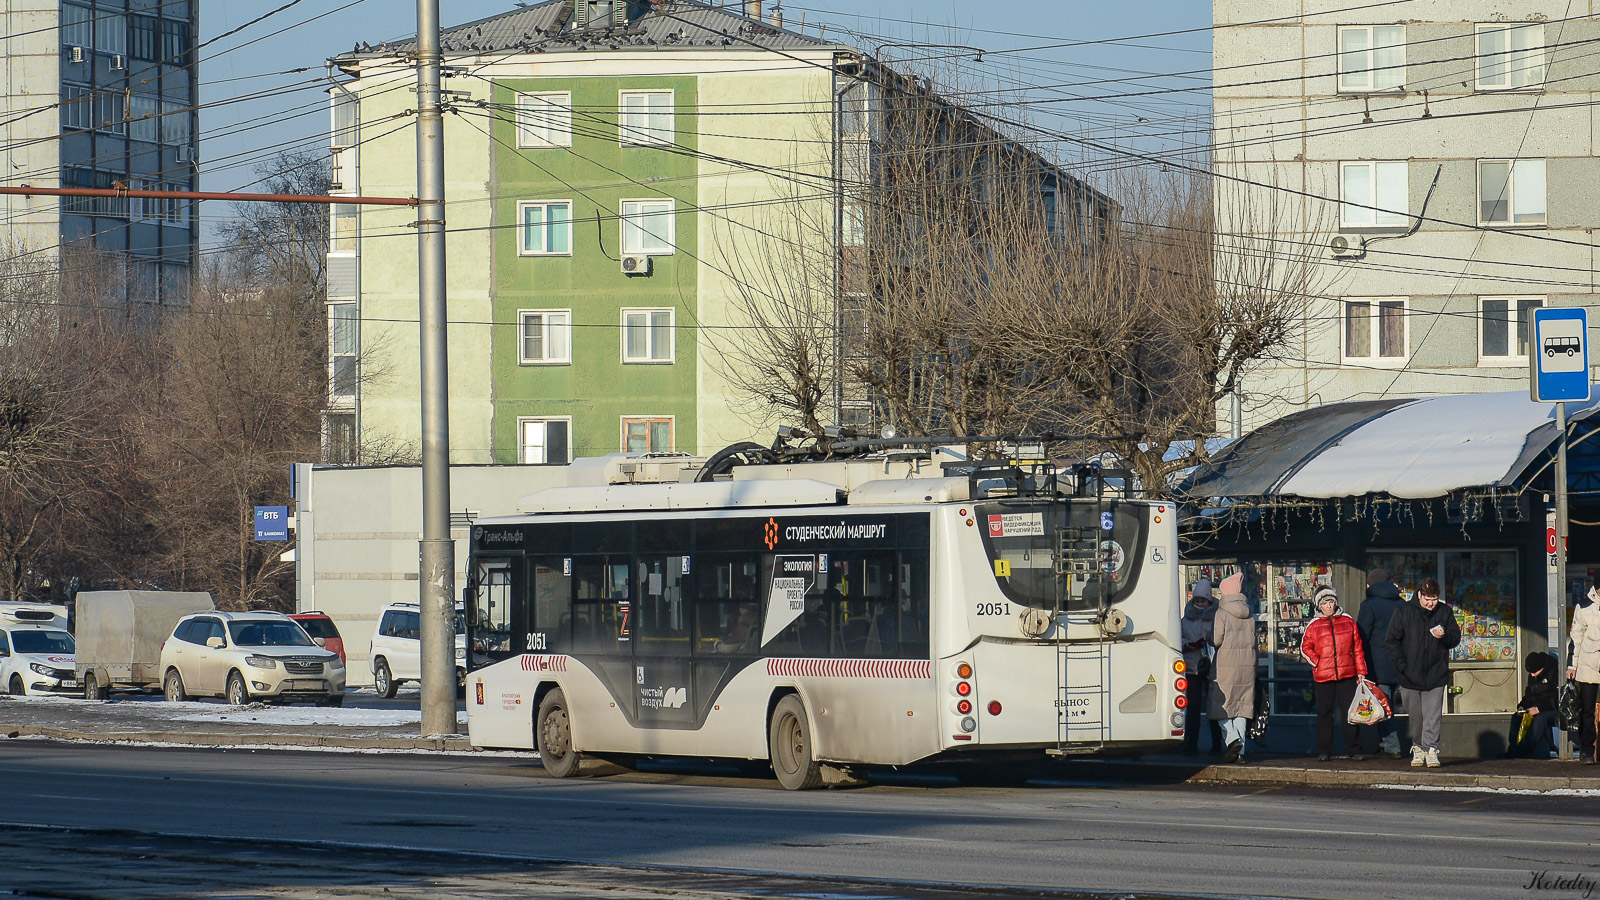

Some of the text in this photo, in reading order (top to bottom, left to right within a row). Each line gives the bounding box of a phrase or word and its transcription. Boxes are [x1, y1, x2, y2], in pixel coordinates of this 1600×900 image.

[263, 511, 279, 520] ВТБ
[1100, 511, 1114, 531] 6
[484, 529, 523, 544] Транс-Альфа
[785, 521, 886, 542] СТУДЕНЧЕСКИЙ МАРШРУТ
[783, 561, 812, 572] ЭКОЛОГИЯ
[786, 589, 803, 600] ПРОЕКТЫ
[789, 600, 803, 610] РОССИИ
[976, 602, 1011, 616] 2051
[526, 632, 547, 651] 2051
[1053, 698, 1090, 707] ВЫНОС
